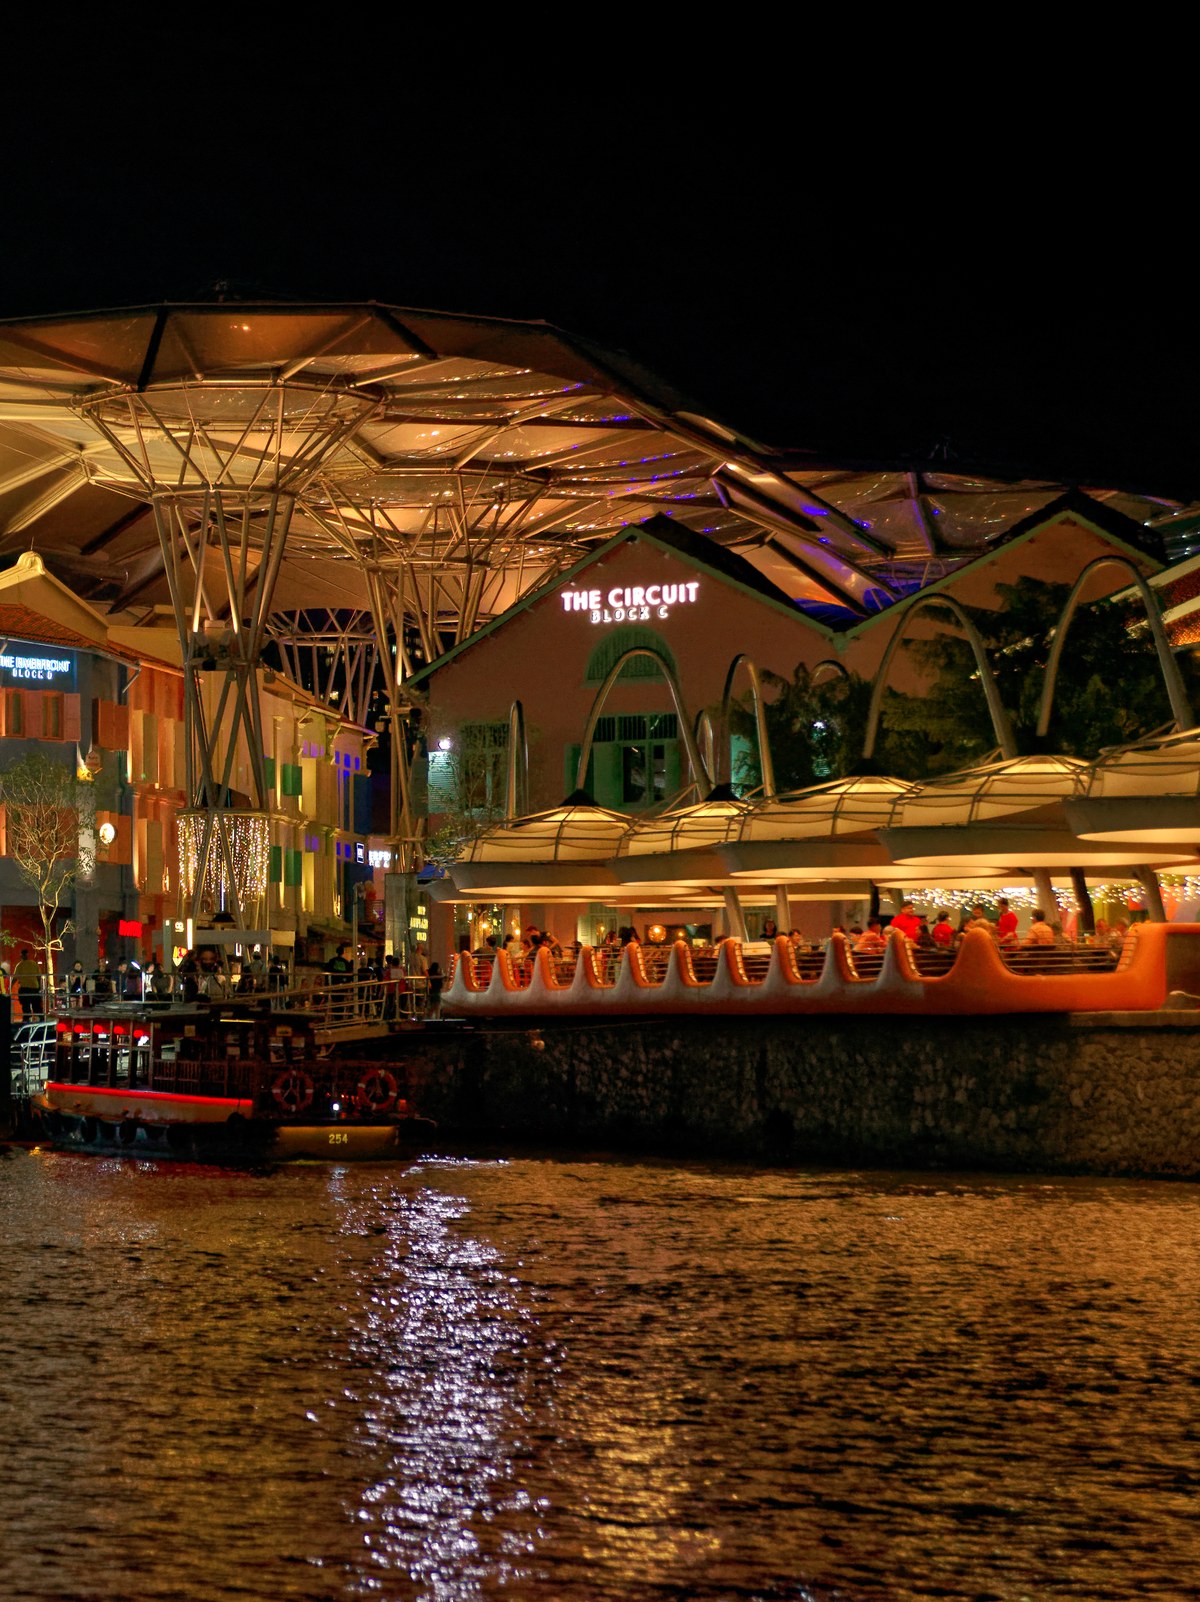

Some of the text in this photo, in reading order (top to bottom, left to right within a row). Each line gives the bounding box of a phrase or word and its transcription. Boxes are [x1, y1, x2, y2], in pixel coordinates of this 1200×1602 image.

[561, 582, 699, 611] THE CIRCUIT
[590, 605, 668, 624] BLOCK C
[15, 656, 71, 673] RIVERFRONT
[12, 668, 44, 679] BLOCK
[328, 1133, 349, 1144] 254
